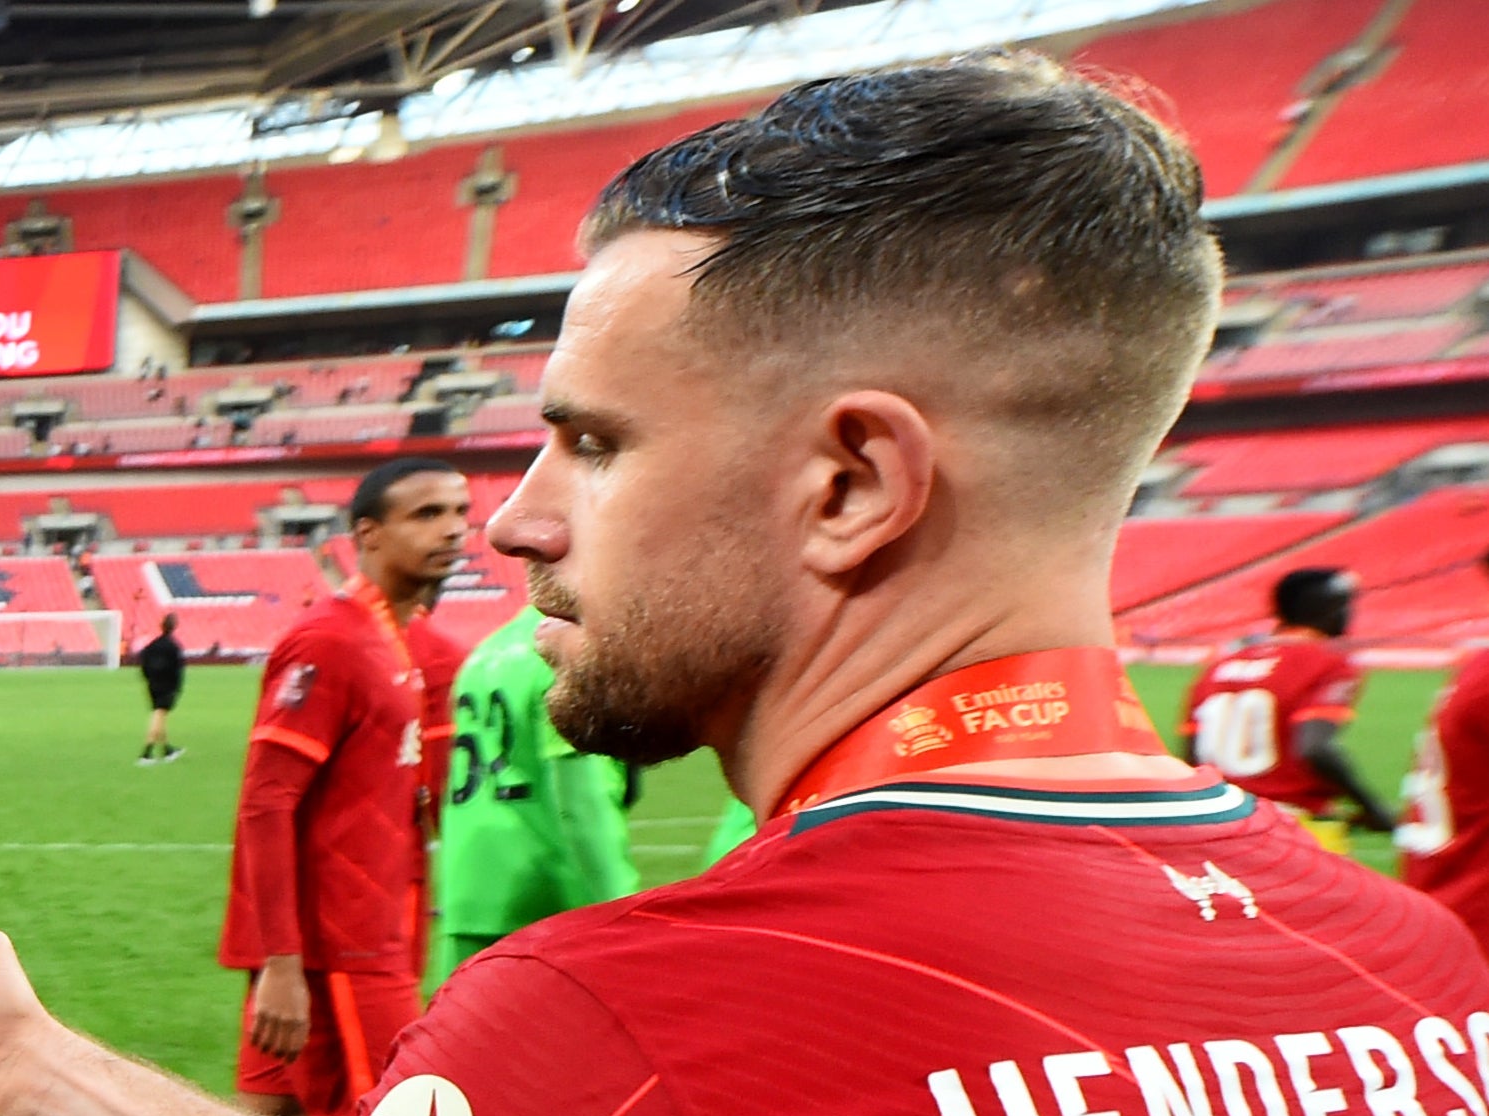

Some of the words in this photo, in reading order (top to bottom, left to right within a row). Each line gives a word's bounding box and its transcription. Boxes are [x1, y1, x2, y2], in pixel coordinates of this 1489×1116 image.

[951, 681, 1066, 713] Emirates
[960, 708, 1009, 734] FA
[1010, 701, 1070, 727] CUP
[452, 689, 533, 804] 62
[1193, 688, 1279, 777] 10
